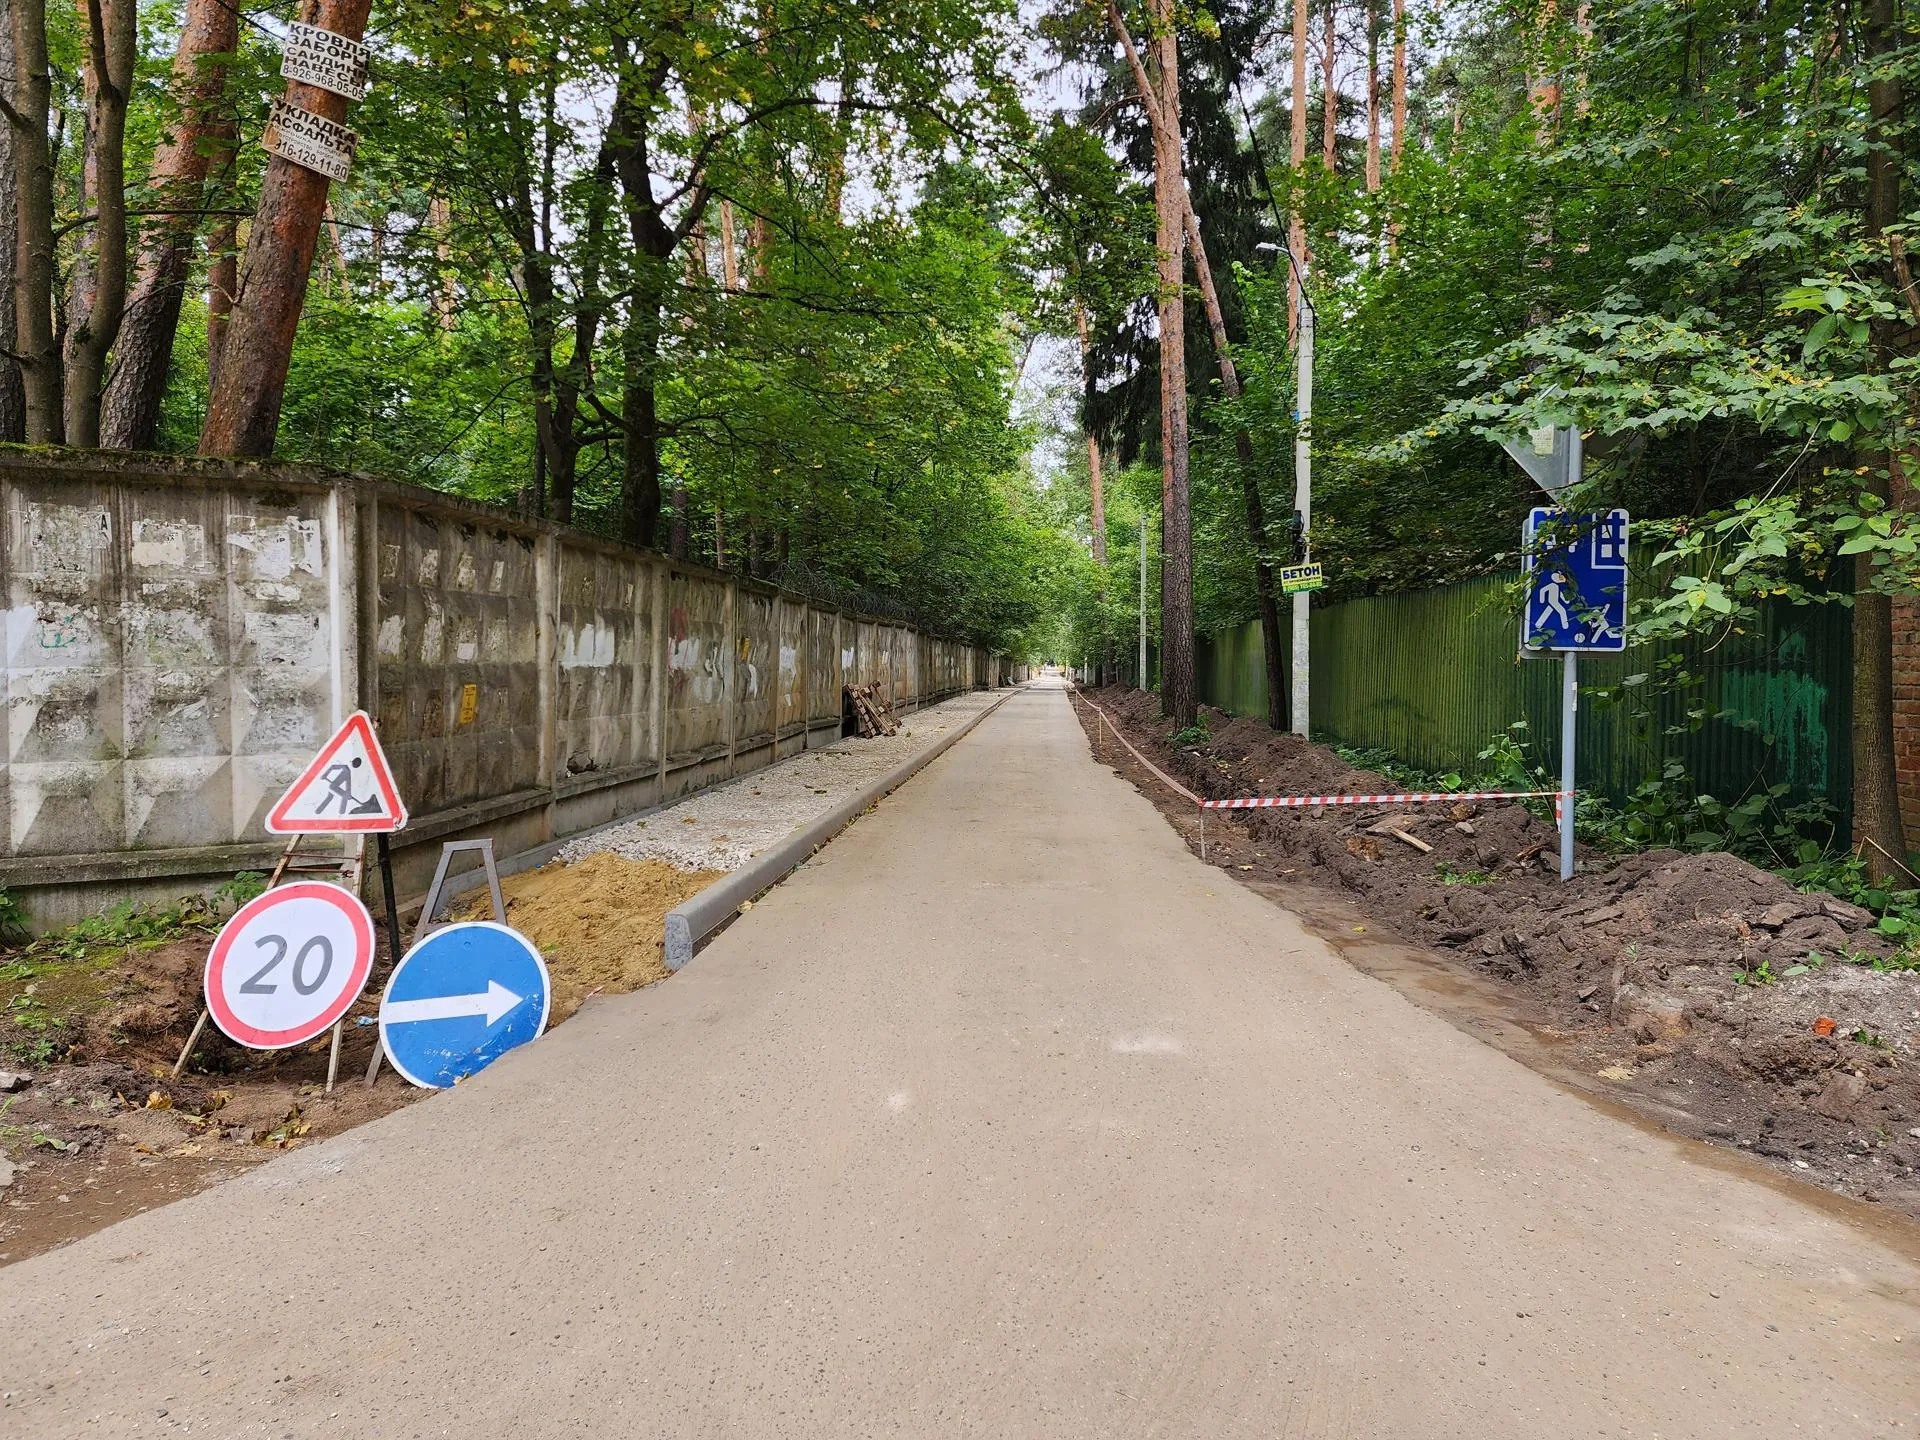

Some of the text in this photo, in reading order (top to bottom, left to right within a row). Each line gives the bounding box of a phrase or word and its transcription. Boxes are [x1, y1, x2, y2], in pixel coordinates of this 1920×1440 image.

[289, 35, 370, 70] ЗАБОРЫ
[290, 24, 371, 59] КРОВЛЯ
[283, 65, 365, 100] 8-926-968-05-05
[284, 56, 367, 90] НАВЕСЫ
[271, 113, 353, 156] АСФАЛЬТА
[274, 99, 356, 145] УКЛАДКА
[1282, 566, 1320, 579] БЕТОН
[239, 934, 333, 996] 20
